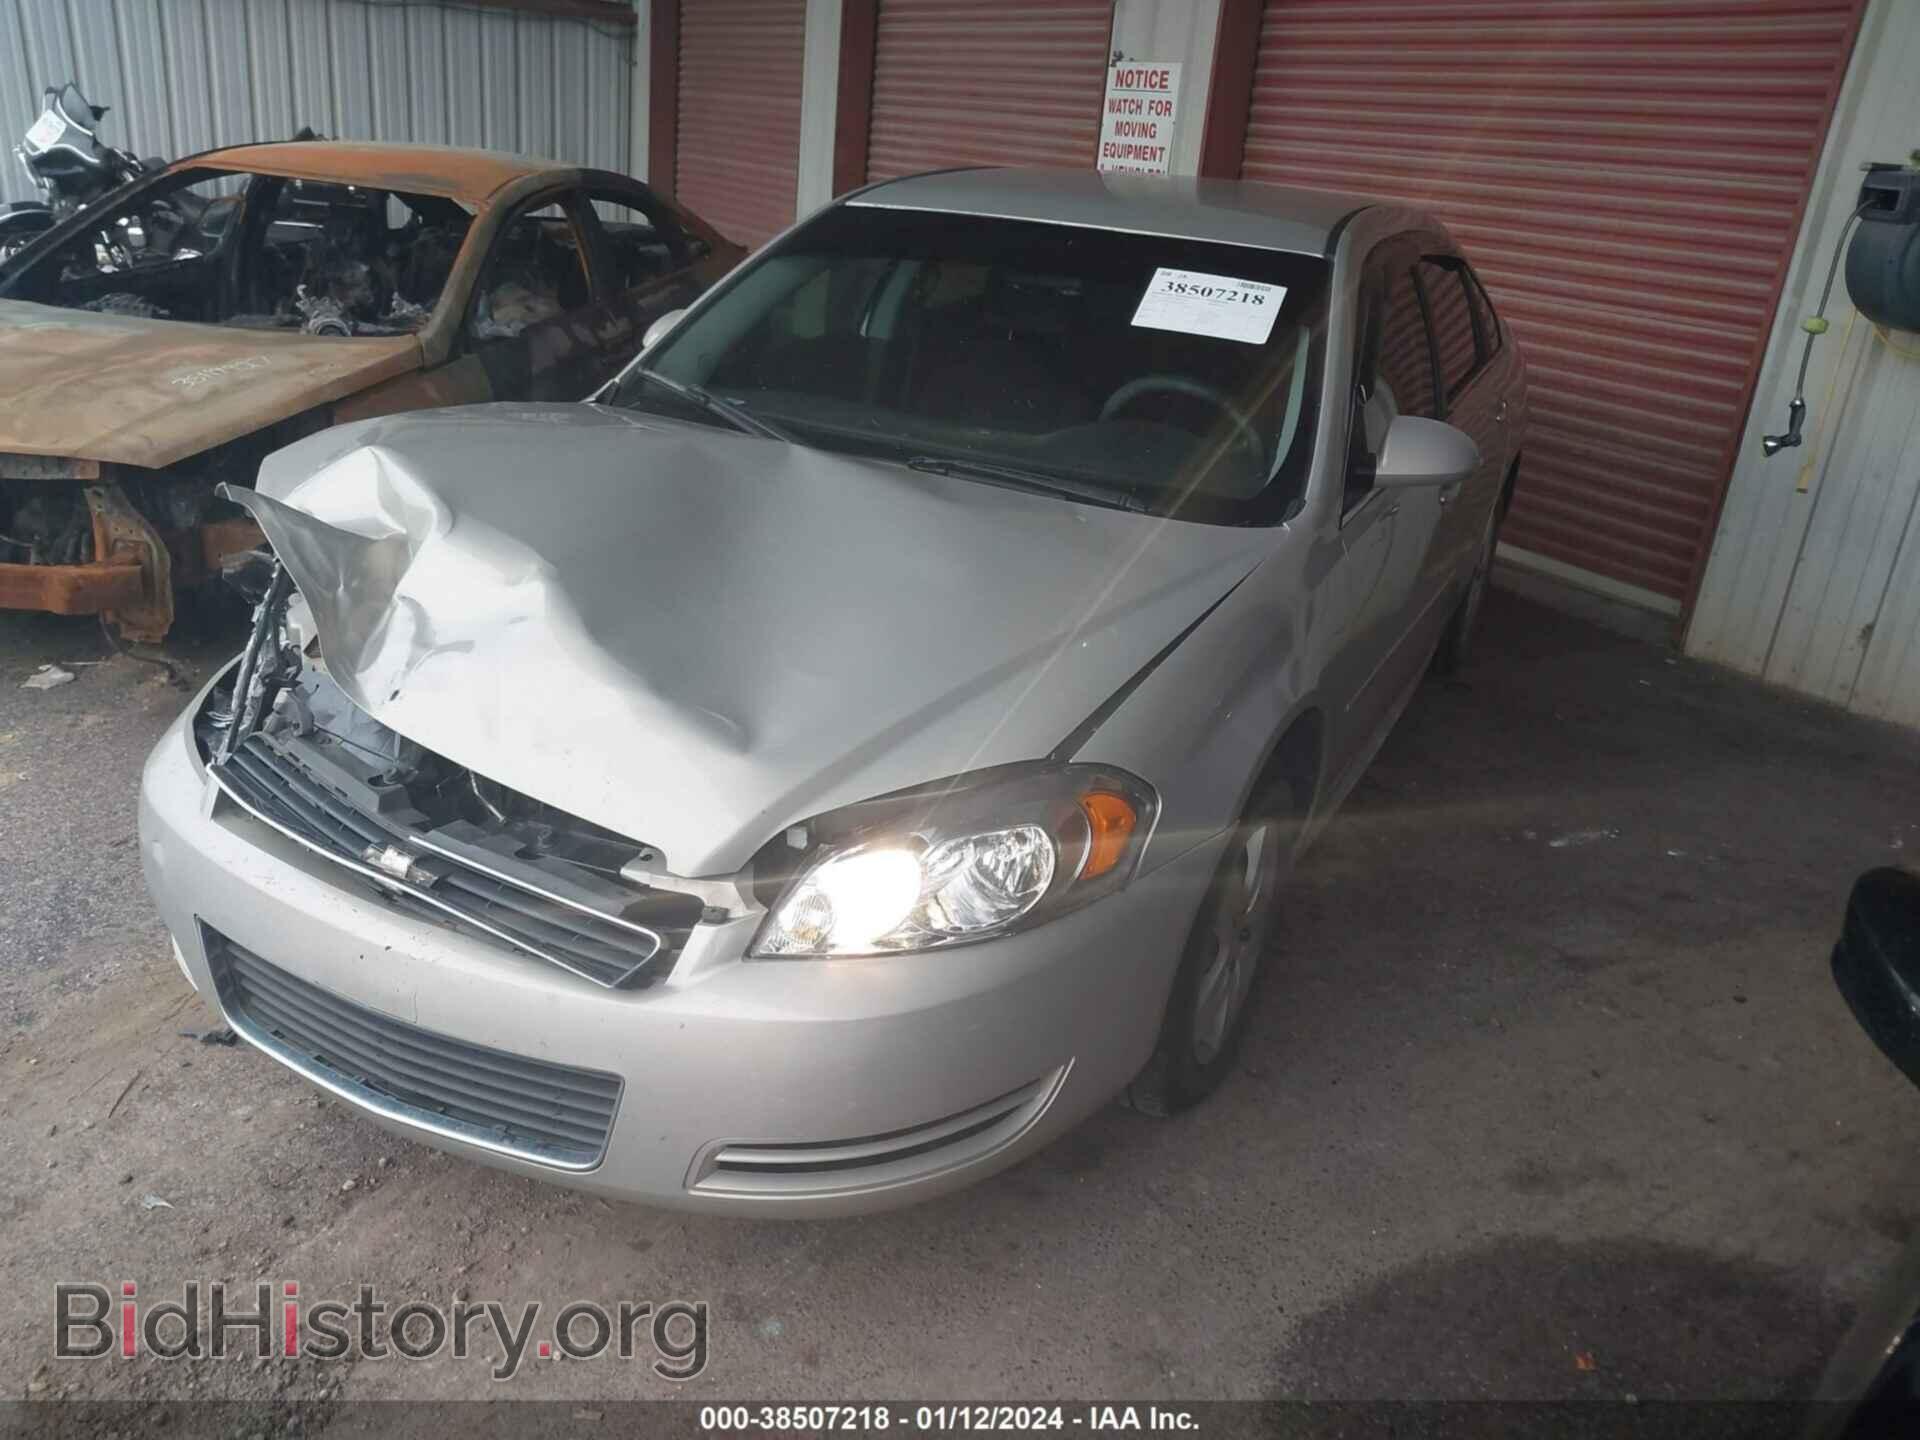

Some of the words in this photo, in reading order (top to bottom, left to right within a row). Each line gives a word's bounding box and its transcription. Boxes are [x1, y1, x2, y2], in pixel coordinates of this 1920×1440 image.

[1114, 69, 1170, 89] NOTICE
[1108, 98, 1143, 115] WATCH
[1147, 100, 1173, 117] FOR
[1114, 121, 1157, 139] MOVING
[1103, 142, 1165, 162] EQUIPMENT
[1161, 281, 1265, 305] 38507218
